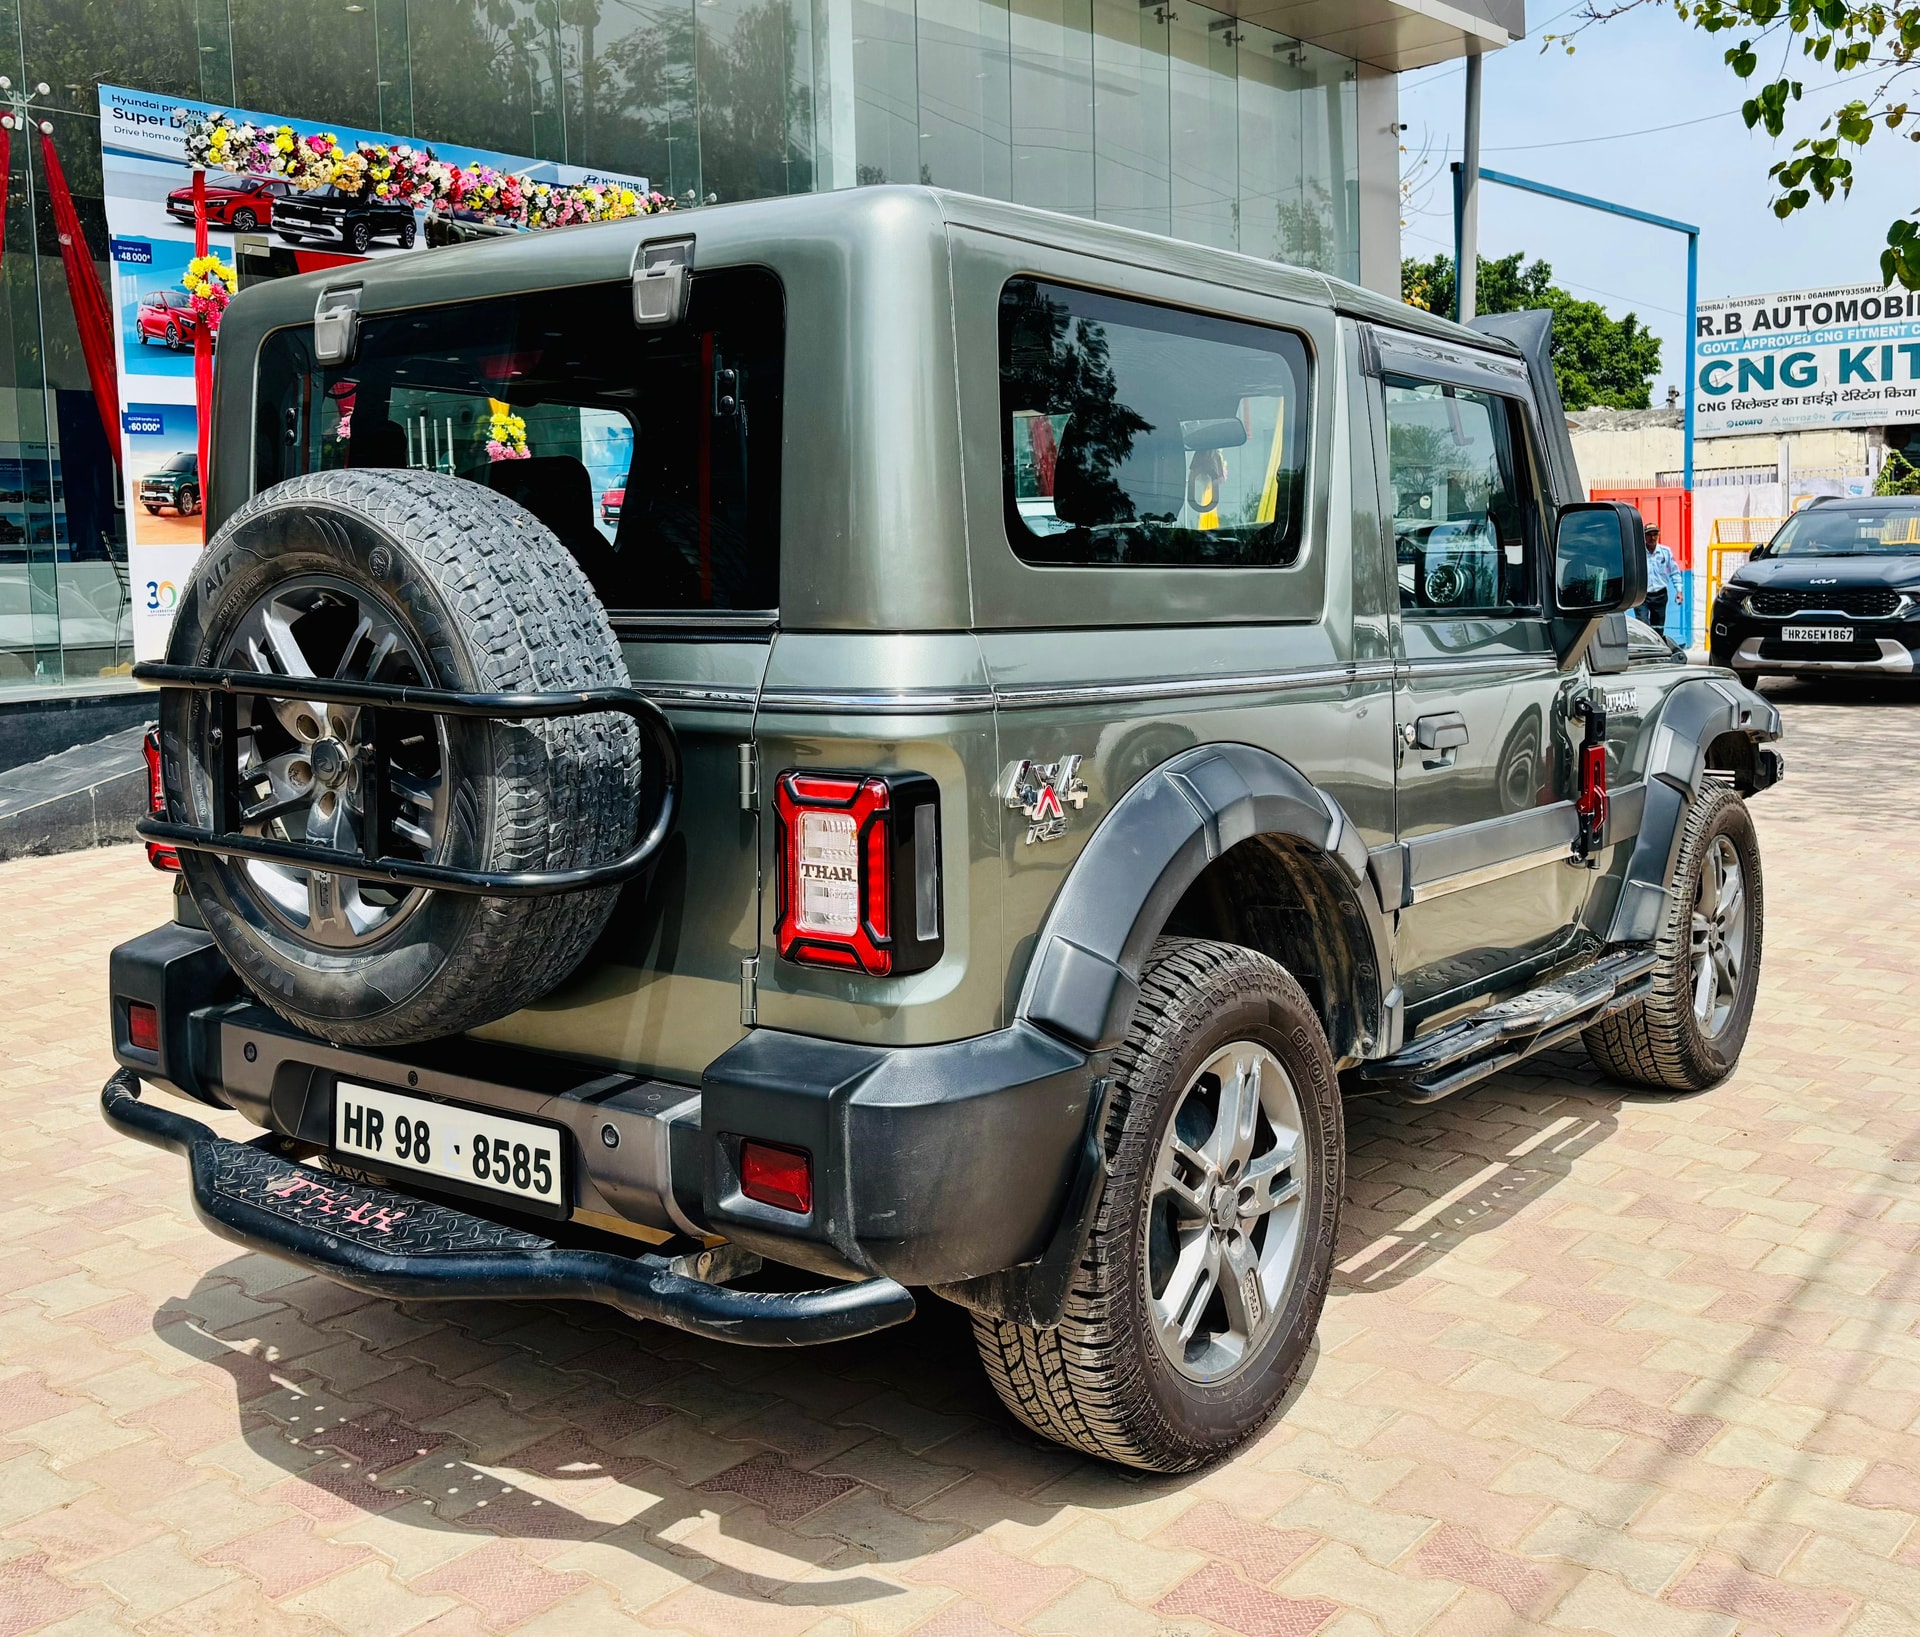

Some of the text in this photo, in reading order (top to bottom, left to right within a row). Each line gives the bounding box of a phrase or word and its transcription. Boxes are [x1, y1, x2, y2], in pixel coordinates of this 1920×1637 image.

[112, 94, 159, 110] Hyundai
[113, 107, 165, 125] Super
[114, 126, 140, 137] Drive
[142, 128, 171, 141] home
[1697, 303, 1724, 313] DESHRAJ
[1777, 294, 1801, 303] GSTIN
[1697, 312, 1742, 337] R.B
[1703, 341, 1739, 354] GOVT.
[1743, 334, 1811, 351] APPROVED
[1815, 330, 1844, 344] CNG
[1848, 325, 1908, 340] FITMENT
[1699, 351, 1818, 396] CNG
[1698, 402, 1726, 413] CNG
[1781, 397, 1799, 406] का
[1884, 386, 1917, 398] किया
[146, 581, 177, 609] 30
[800, 863, 857, 882] THAR
[344, 1102, 552, 1194] HR 98 8585
[1290, 1025, 1338, 1249] GEOLANDAR
